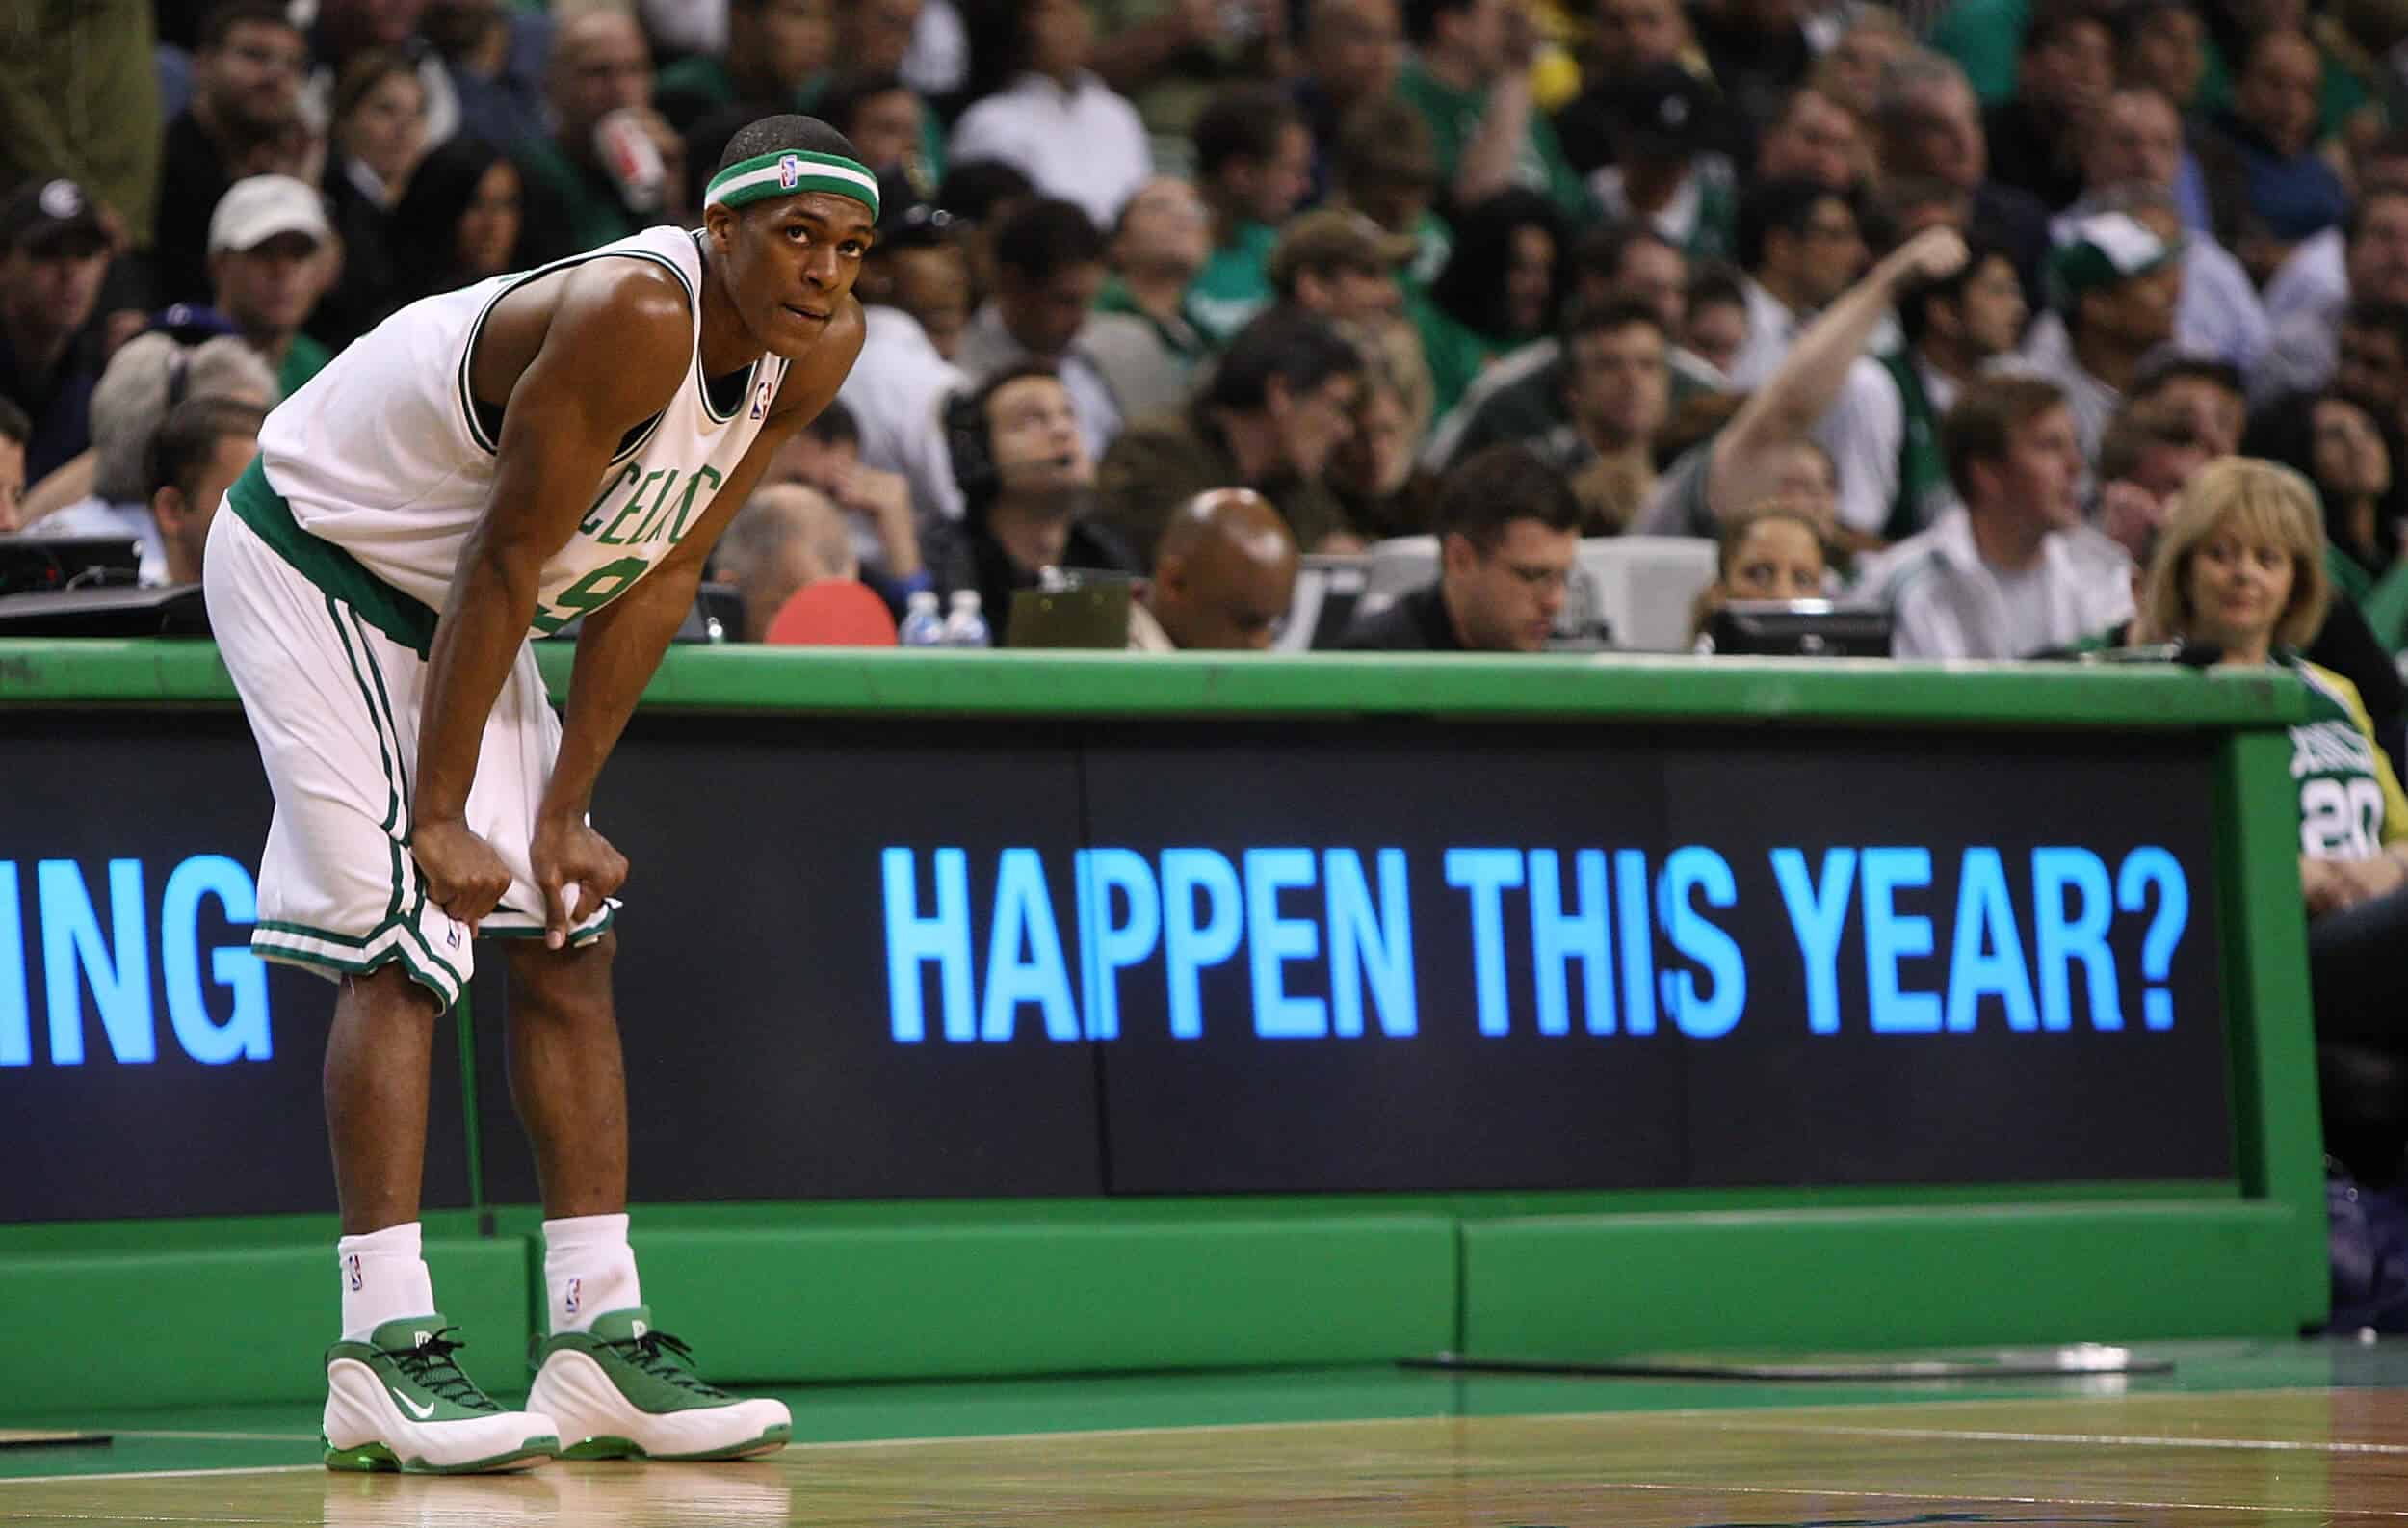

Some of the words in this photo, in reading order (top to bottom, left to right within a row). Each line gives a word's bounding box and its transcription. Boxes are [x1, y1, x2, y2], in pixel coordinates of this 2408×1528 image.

[531, 556, 649, 633] 9
[2300, 777, 2384, 860] 20
[0, 856, 274, 1067] ING
[881, 847, 1419, 1043] HAPPEN
[1444, 847, 1747, 1039] THIS
[1769, 847, 2189, 1033] YEAR?
